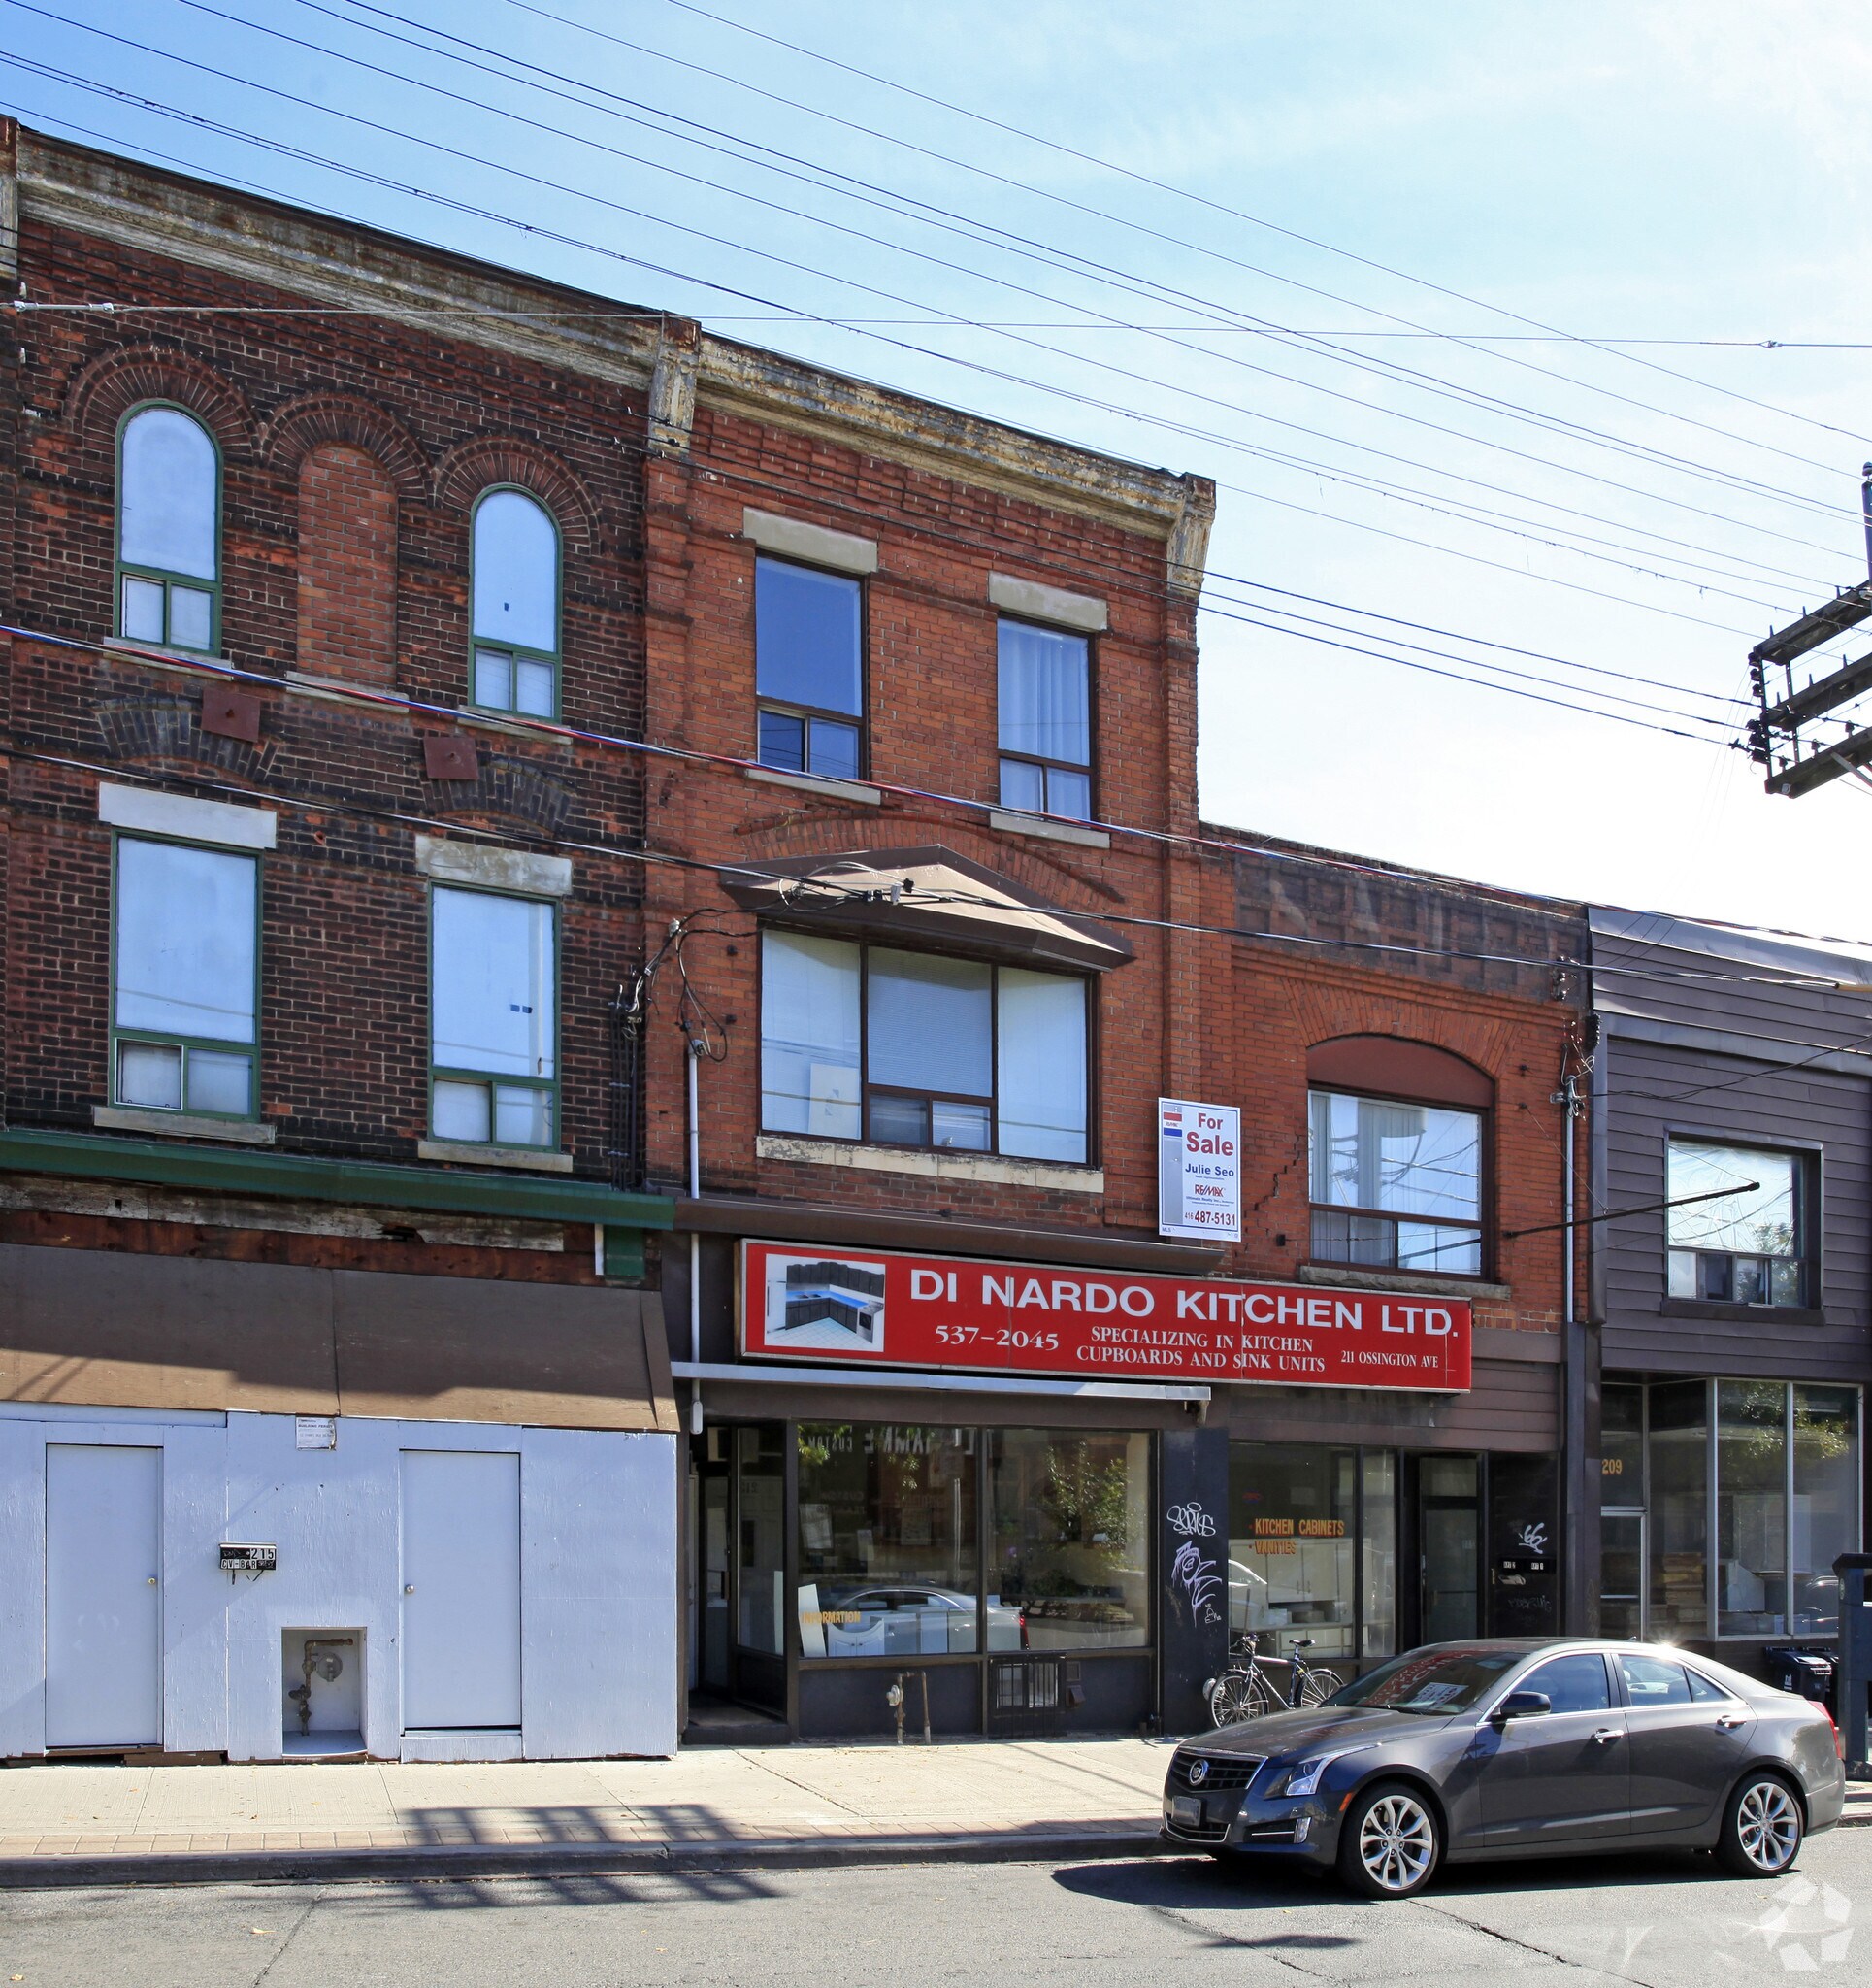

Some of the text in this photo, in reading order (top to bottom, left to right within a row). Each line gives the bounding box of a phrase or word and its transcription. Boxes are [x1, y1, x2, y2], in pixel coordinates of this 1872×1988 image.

[1198, 1112, 1224, 1130] For
[1186, 1131, 1234, 1156] Sale
[1185, 1163, 1234, 1177] Julie Seo
[1195, 1184, 1224, 1197] RE/MAX
[1184, 1210, 1235, 1226] 416 487-5131
[910, 1269, 1459, 1338] DI NARDO KITCHEN LTD.
[935, 1325, 1059, 1351] 537-2045
[1091, 1326, 1313, 1352] SPECIALIZING IN KITCHEN
[1076, 1345, 1326, 1372] CUPBOARDS AND SINK UNITS
[1340, 1350, 1439, 1368] 211 OSSINGTON AVE
[1601, 1459, 1623, 1474] 209
[1255, 1518, 1345, 1537] KITCHEN CABINETS
[250, 1548, 274, 1560] 215
[1254, 1540, 1297, 1555] VANITIES
[802, 1611, 861, 1624] INFORMATION
